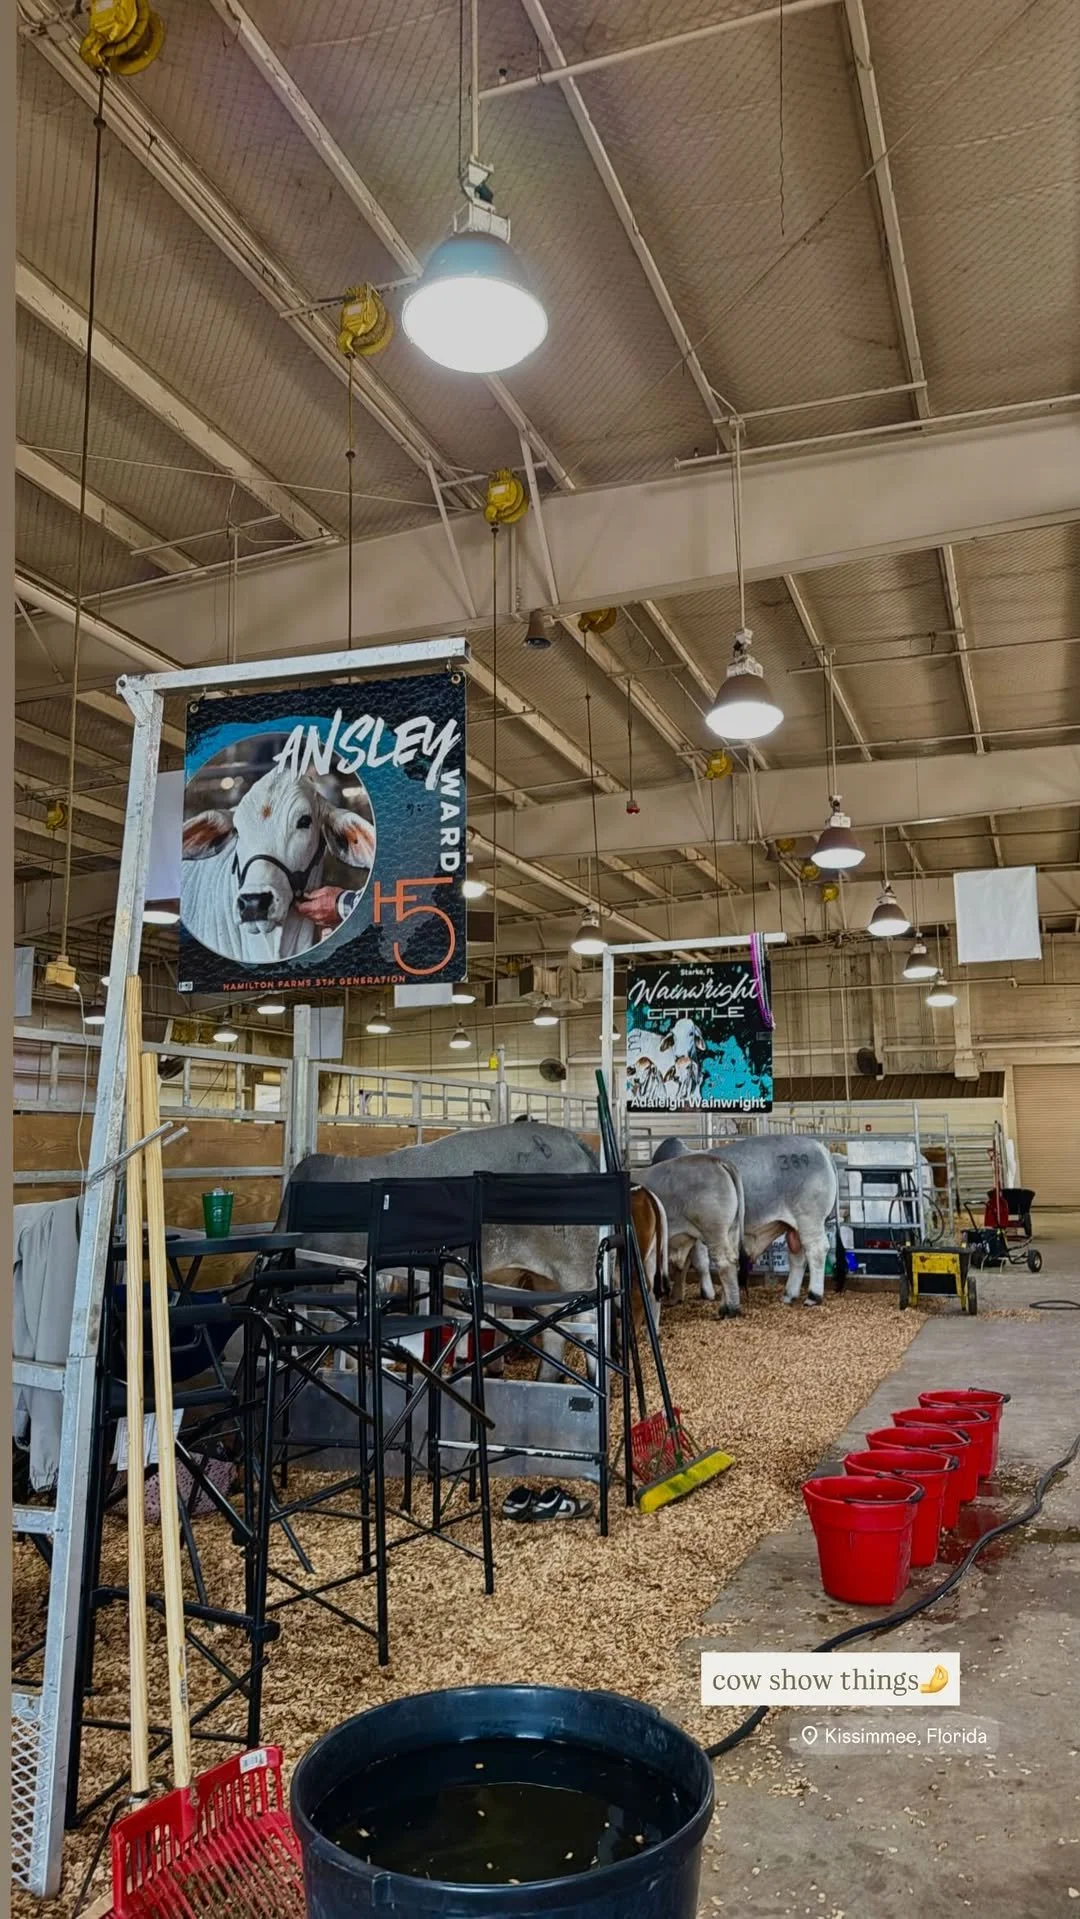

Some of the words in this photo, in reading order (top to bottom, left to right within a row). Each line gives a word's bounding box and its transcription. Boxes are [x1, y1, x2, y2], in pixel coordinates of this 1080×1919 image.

[272, 707, 463, 790] ANSLEY
[440, 769, 461, 872] WARD
[223, 981, 274, 991] HAMILTON
[277, 979, 311, 989] FARMS
[339, 975, 406, 987] GENERATION
[628, 971, 760, 1007] Wainwright
[647, 1006, 745, 1020] CATTLE
[631, 1096, 685, 1111] Adaleigh
[688, 1096, 767, 1112] Wainwright
